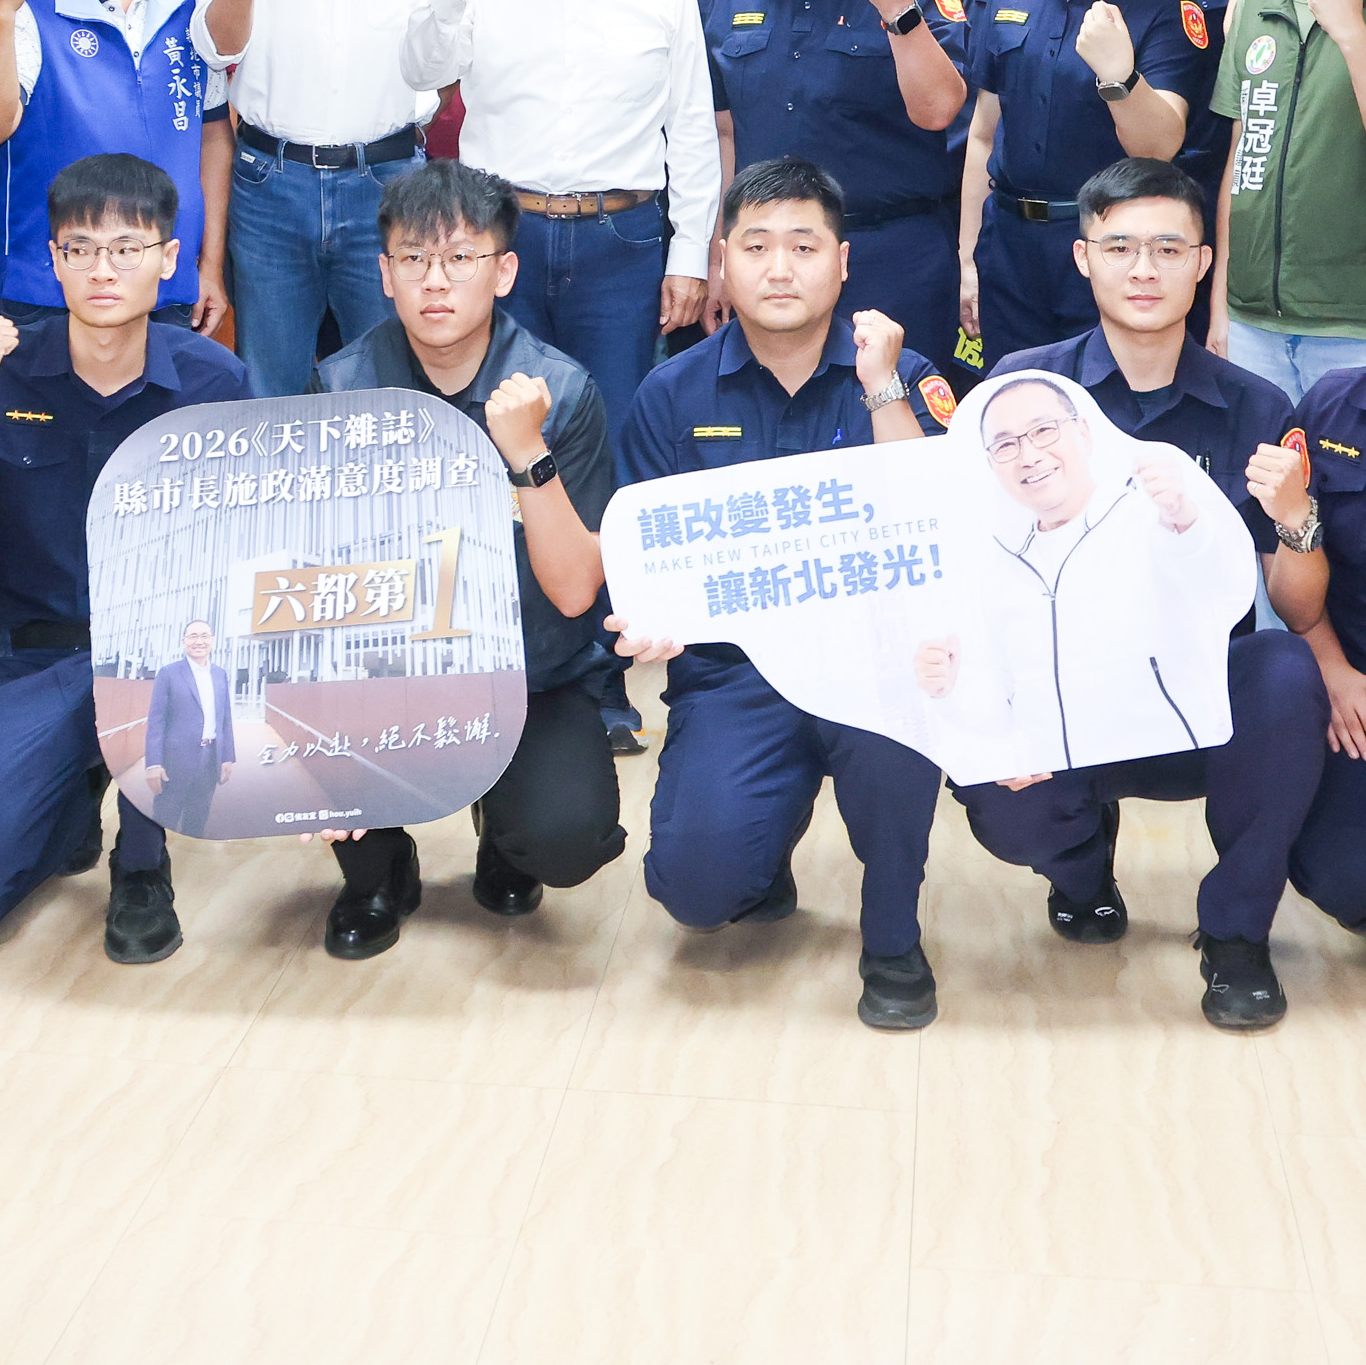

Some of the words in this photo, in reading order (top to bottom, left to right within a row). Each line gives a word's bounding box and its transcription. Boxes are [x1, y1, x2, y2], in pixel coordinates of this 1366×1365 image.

[163, 37, 193, 131] 黃永昌
[1241, 80, 1279, 191] 卓冠廷
[112, 453, 480, 517] 縣市長施政滿意度調查
[644, 555, 694, 576] MAKE
[703, 548, 742, 567] NEW
[751, 538, 811, 559] TAIPEI
[820, 529, 861, 549] CITY
[869, 518, 941, 542] BETTER
